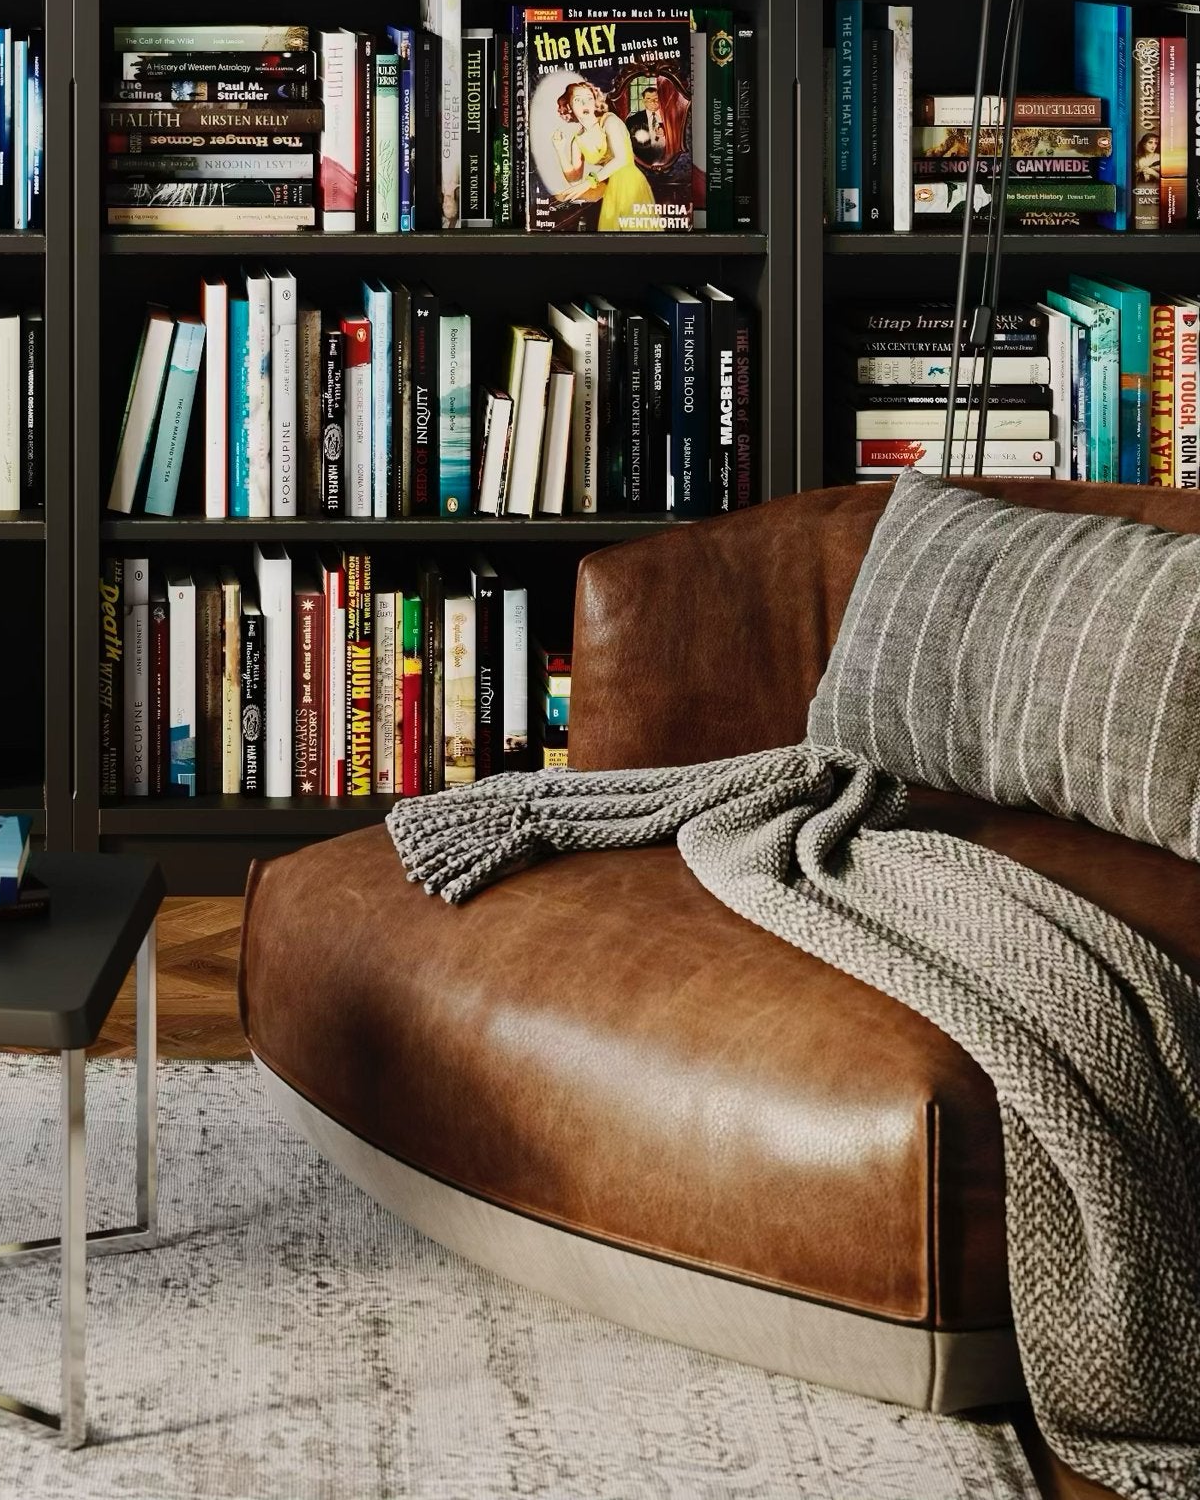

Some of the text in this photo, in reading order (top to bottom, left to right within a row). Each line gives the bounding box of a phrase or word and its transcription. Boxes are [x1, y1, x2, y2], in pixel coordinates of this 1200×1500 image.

[126, 37, 194, 45] The Call of the Wild
[534, 24, 617, 62] the KEY
[467, 50, 481, 134] THE HOBBIT
[842, 16, 852, 126] THE CAT IN THE HAT
[200, 114, 289, 126] KIRSTEN KELLY
[452, 96, 460, 140] HEYER
[1018, 104, 1096, 114] BEETLEJUICE
[618, 217, 689, 229] WENTWORTH
[632, 204, 687, 216] PATRICIA
[864, 344, 930, 352] A SIX CENTURY
[867, 316, 912, 332] kitap
[684, 315, 695, 413] THE KING'S BLOOD
[720, 350, 732, 445] MACBETH
[1152, 306, 1174, 488] PLAY IT HARD
[1178, 333, 1197, 464] RUN TOUGH, RUN
[480, 666, 494, 724] INIQUITY
[134, 701, 143, 784] PORCUPINE
[246, 745, 257, 790] HARPER LEE
[296, 708, 308, 778] HOGWARTS
[308, 709, 318, 776] A HISTORY
[352, 708, 372, 796] MYSTERY
